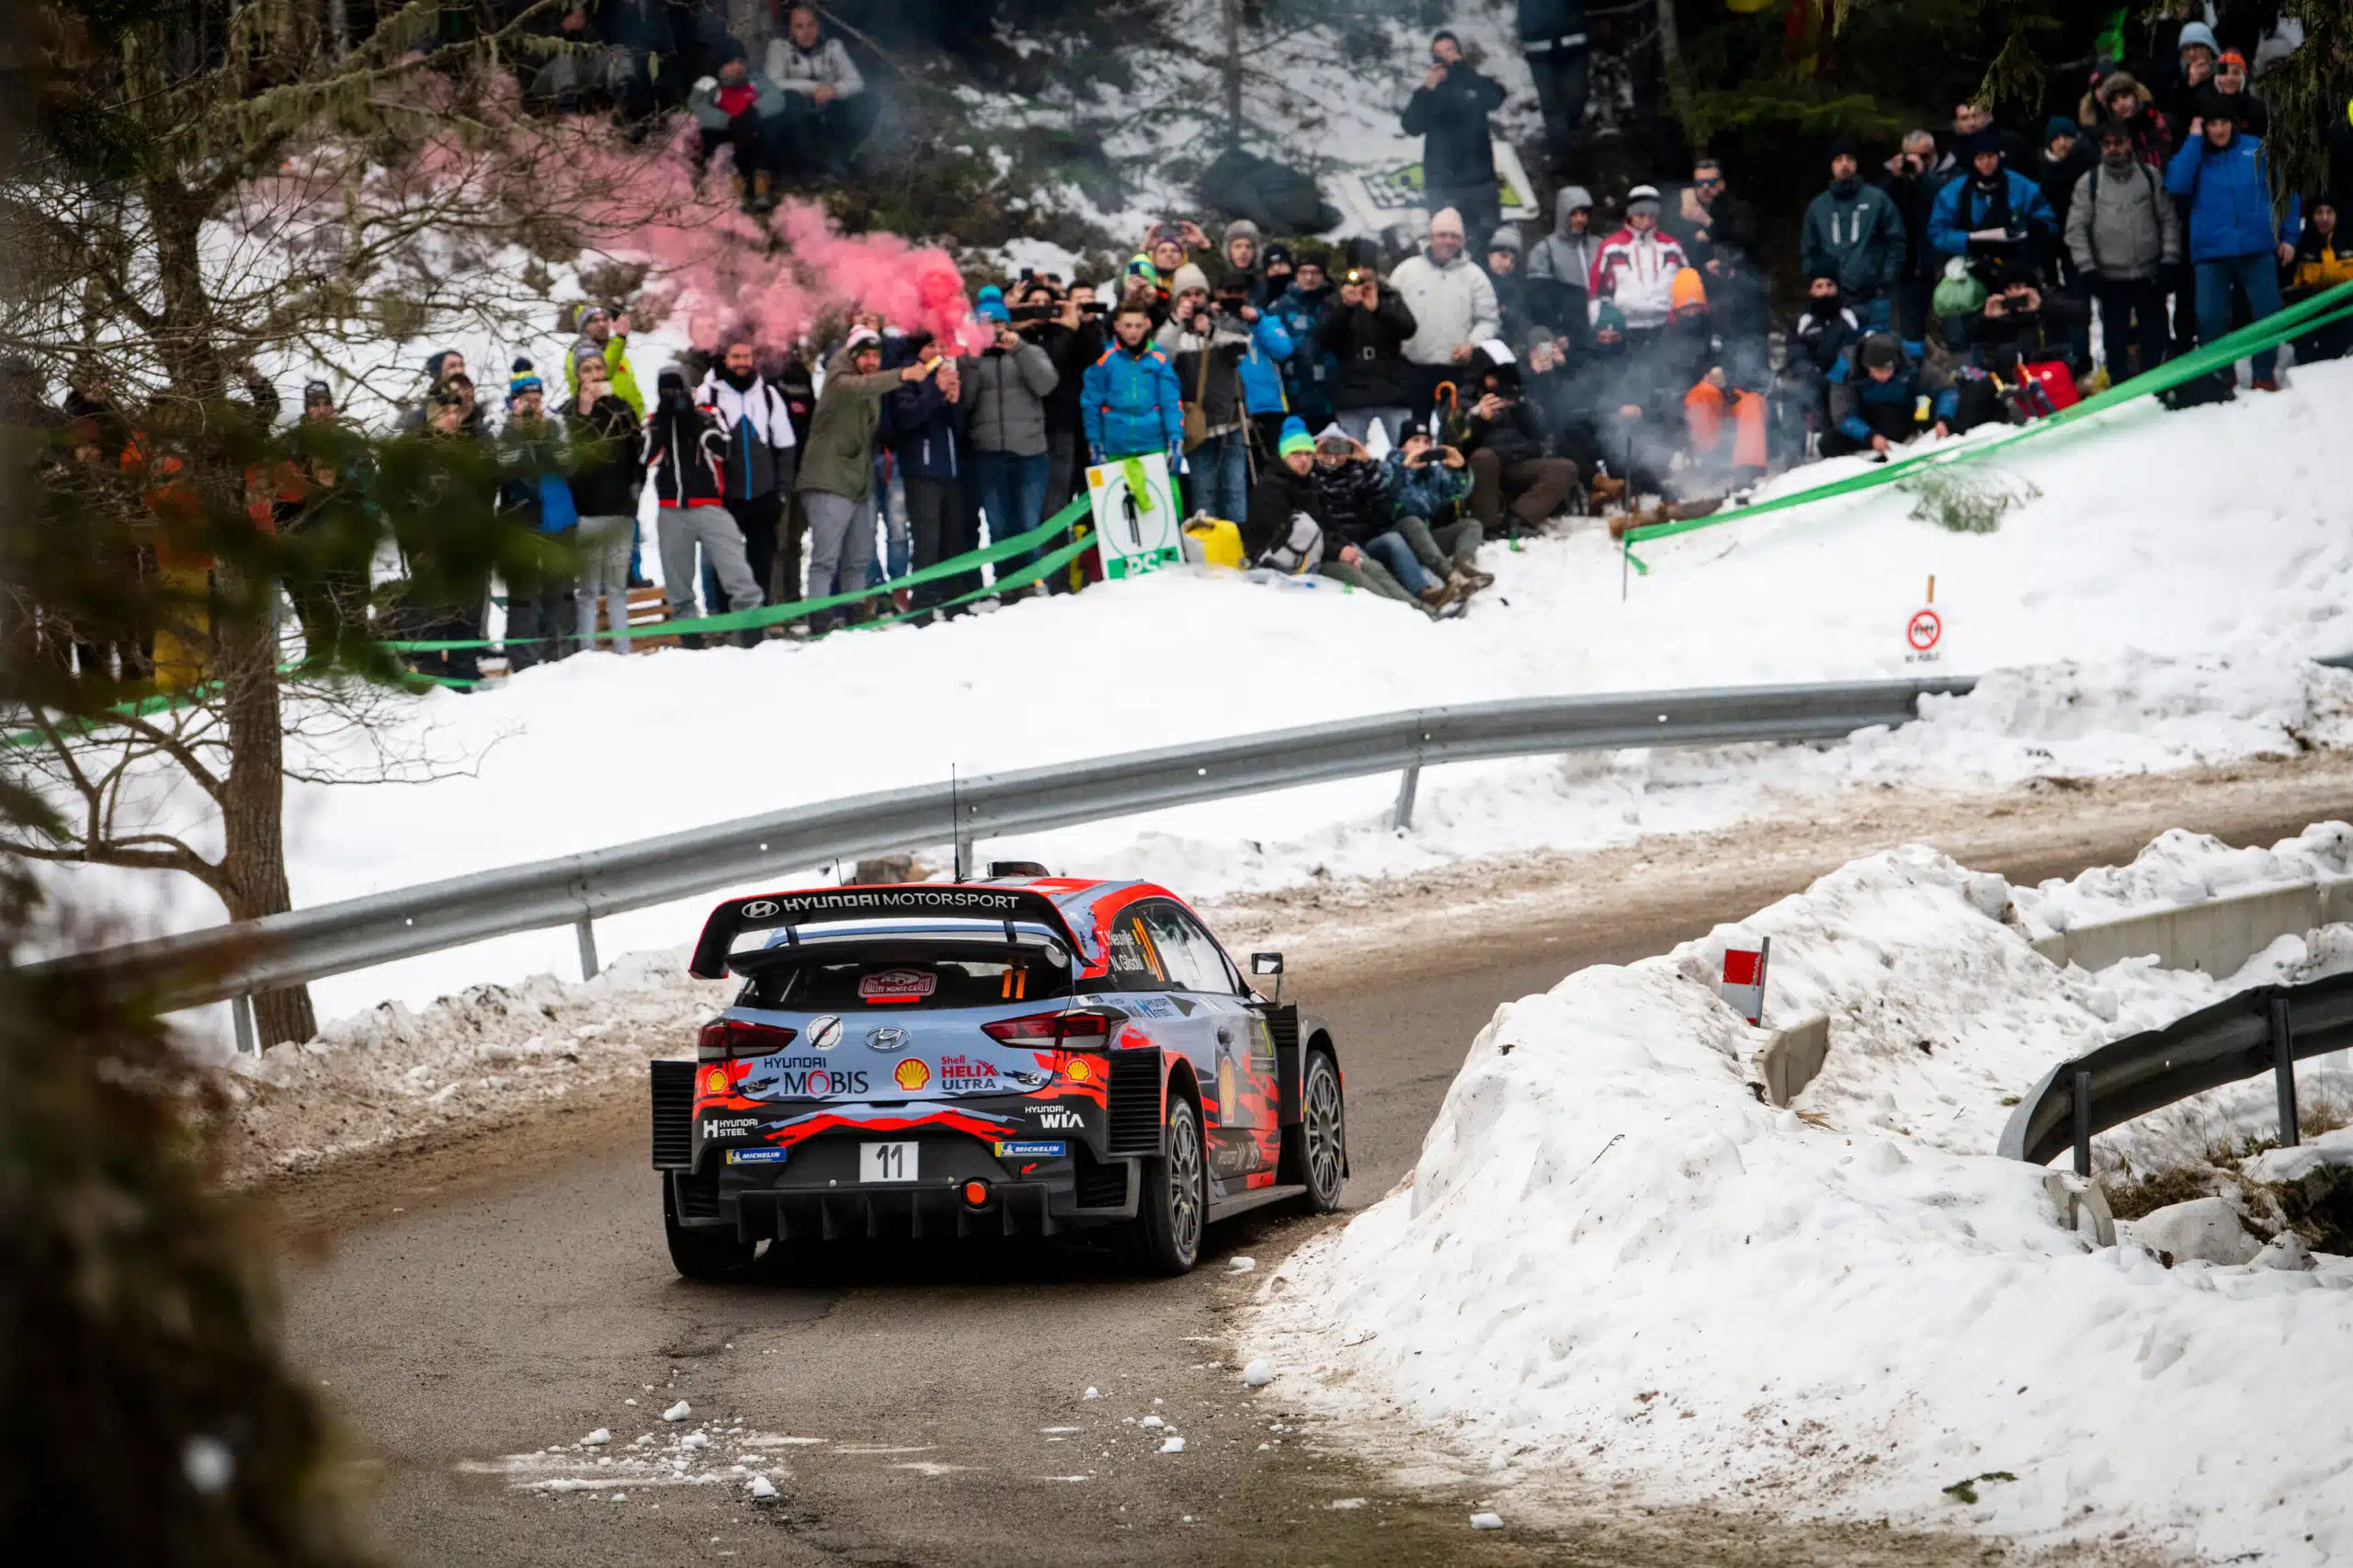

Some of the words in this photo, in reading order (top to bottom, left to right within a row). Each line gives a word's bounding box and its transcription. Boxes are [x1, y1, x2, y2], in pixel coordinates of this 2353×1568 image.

[783, 893, 880, 912] HYUNDAI
[883, 892, 1019, 909] MOTORSPORT
[1002, 969, 1027, 999] 11
[764, 1057, 827, 1069] HYUNDAI
[940, 1054, 966, 1065] Shell
[940, 1062, 999, 1078] HELIX
[784, 1069, 870, 1096] MOBIS
[941, 1078, 997, 1090] ULTRA
[1025, 1105, 1064, 1114] HYUNDAI
[719, 1118, 758, 1128] HYUNDAI
[1040, 1110, 1086, 1129] WIA
[719, 1128, 749, 1137] STEEL
[1014, 1145, 1060, 1153] MICHELIN
[742, 1151, 781, 1160] MICHELIN
[875, 1144, 903, 1178] 11
